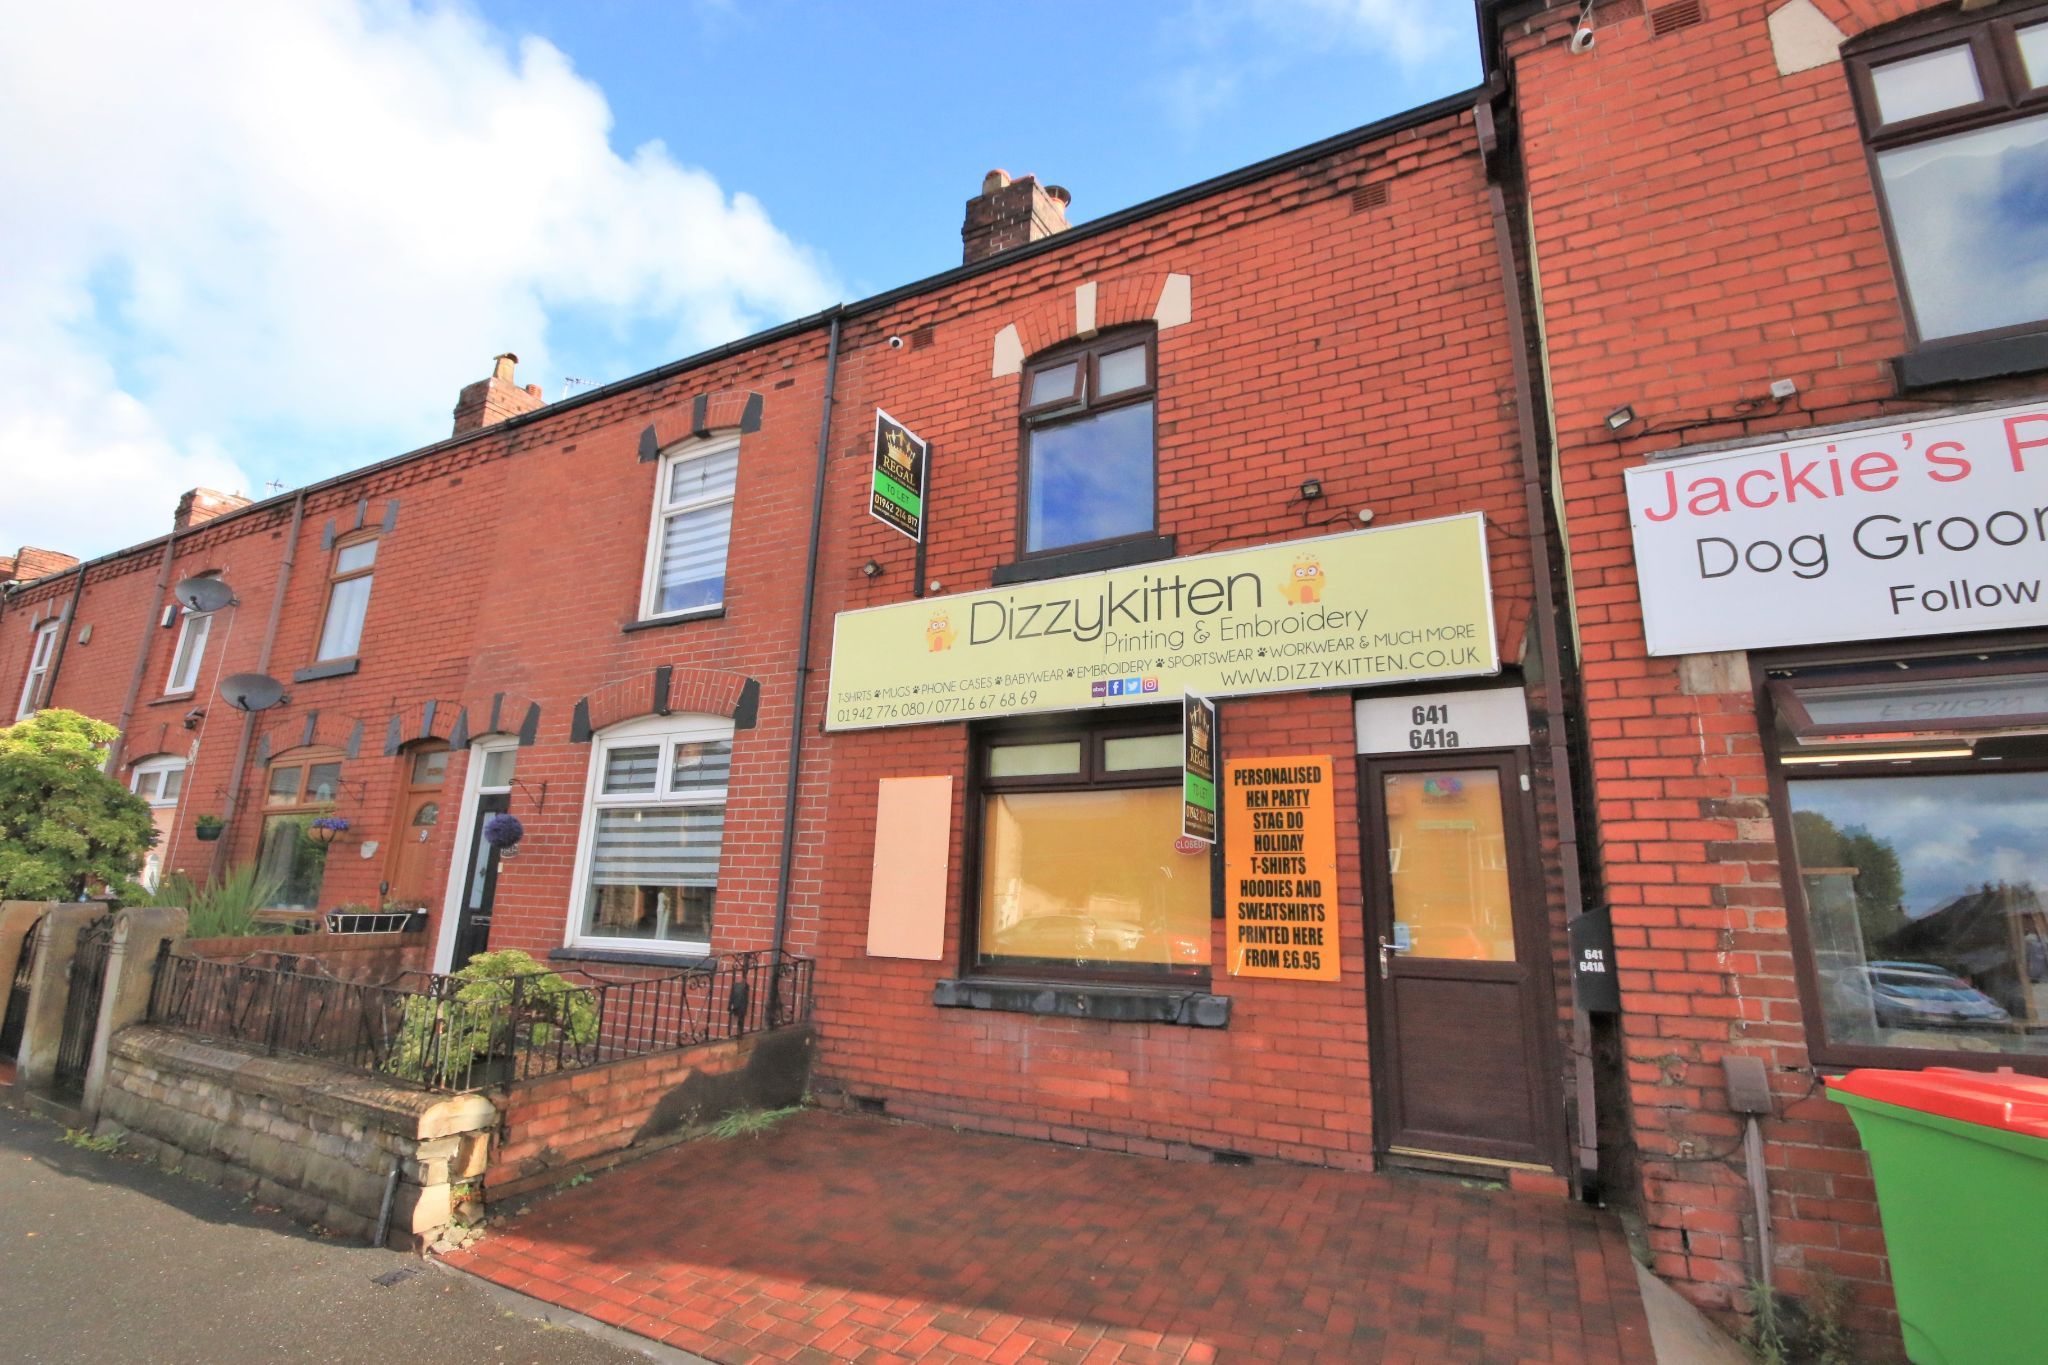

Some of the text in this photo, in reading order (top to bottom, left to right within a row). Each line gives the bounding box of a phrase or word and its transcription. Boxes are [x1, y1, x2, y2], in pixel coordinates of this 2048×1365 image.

[883, 455, 915, 485] REGAL
[1644, 432, 1972, 523] Jackie's
[887, 483, 910, 503] TO LET
[874, 494, 894, 513] 01942
[895, 507, 906, 520] 214
[907, 514, 918, 527] 817
[1697, 533, 1829, 580] Dog
[1888, 579, 2041, 615] Follow
[969, 571, 1263, 647] Dizzykitten
[1104, 606, 1369, 655] Printing & Embroidery
[838, 624, 1476, 704] T-SHIRTS MUGS PHONE CASES BABYWEAR EMBROIDERY SPORTSWEAR WORKWEAR & MUCH MORE
[1221, 646, 1481, 687] WWW.DIZZYKITTEN.CO.UK
[837, 690, 1038, 722] 01942 776 080 / 07716 67 68 69
[1412, 704, 1449, 726] 641
[1409, 728, 1460, 750] 641a
[1189, 745, 1211, 770] REGAL
[1234, 766, 1321, 786] PERSONALISED
[1246, 789, 1310, 808] HEN PARTY
[1253, 811, 1304, 829] STAG DO
[1175, 840, 1204, 849] CLOSED
[1254, 834, 1304, 852] HOLIDAY
[1250, 857, 1306, 875] T-SHIRTS
[1240, 880, 1322, 898] HOODIES AND
[1238, 902, 1325, 922] SWEATSHIRTS
[1238, 925, 1324, 946] PRINTED HERE
[1245, 949, 1321, 970] FROM £6.95
[1584, 949, 1603, 960] 641
[1580, 961, 1605, 973] 641A
